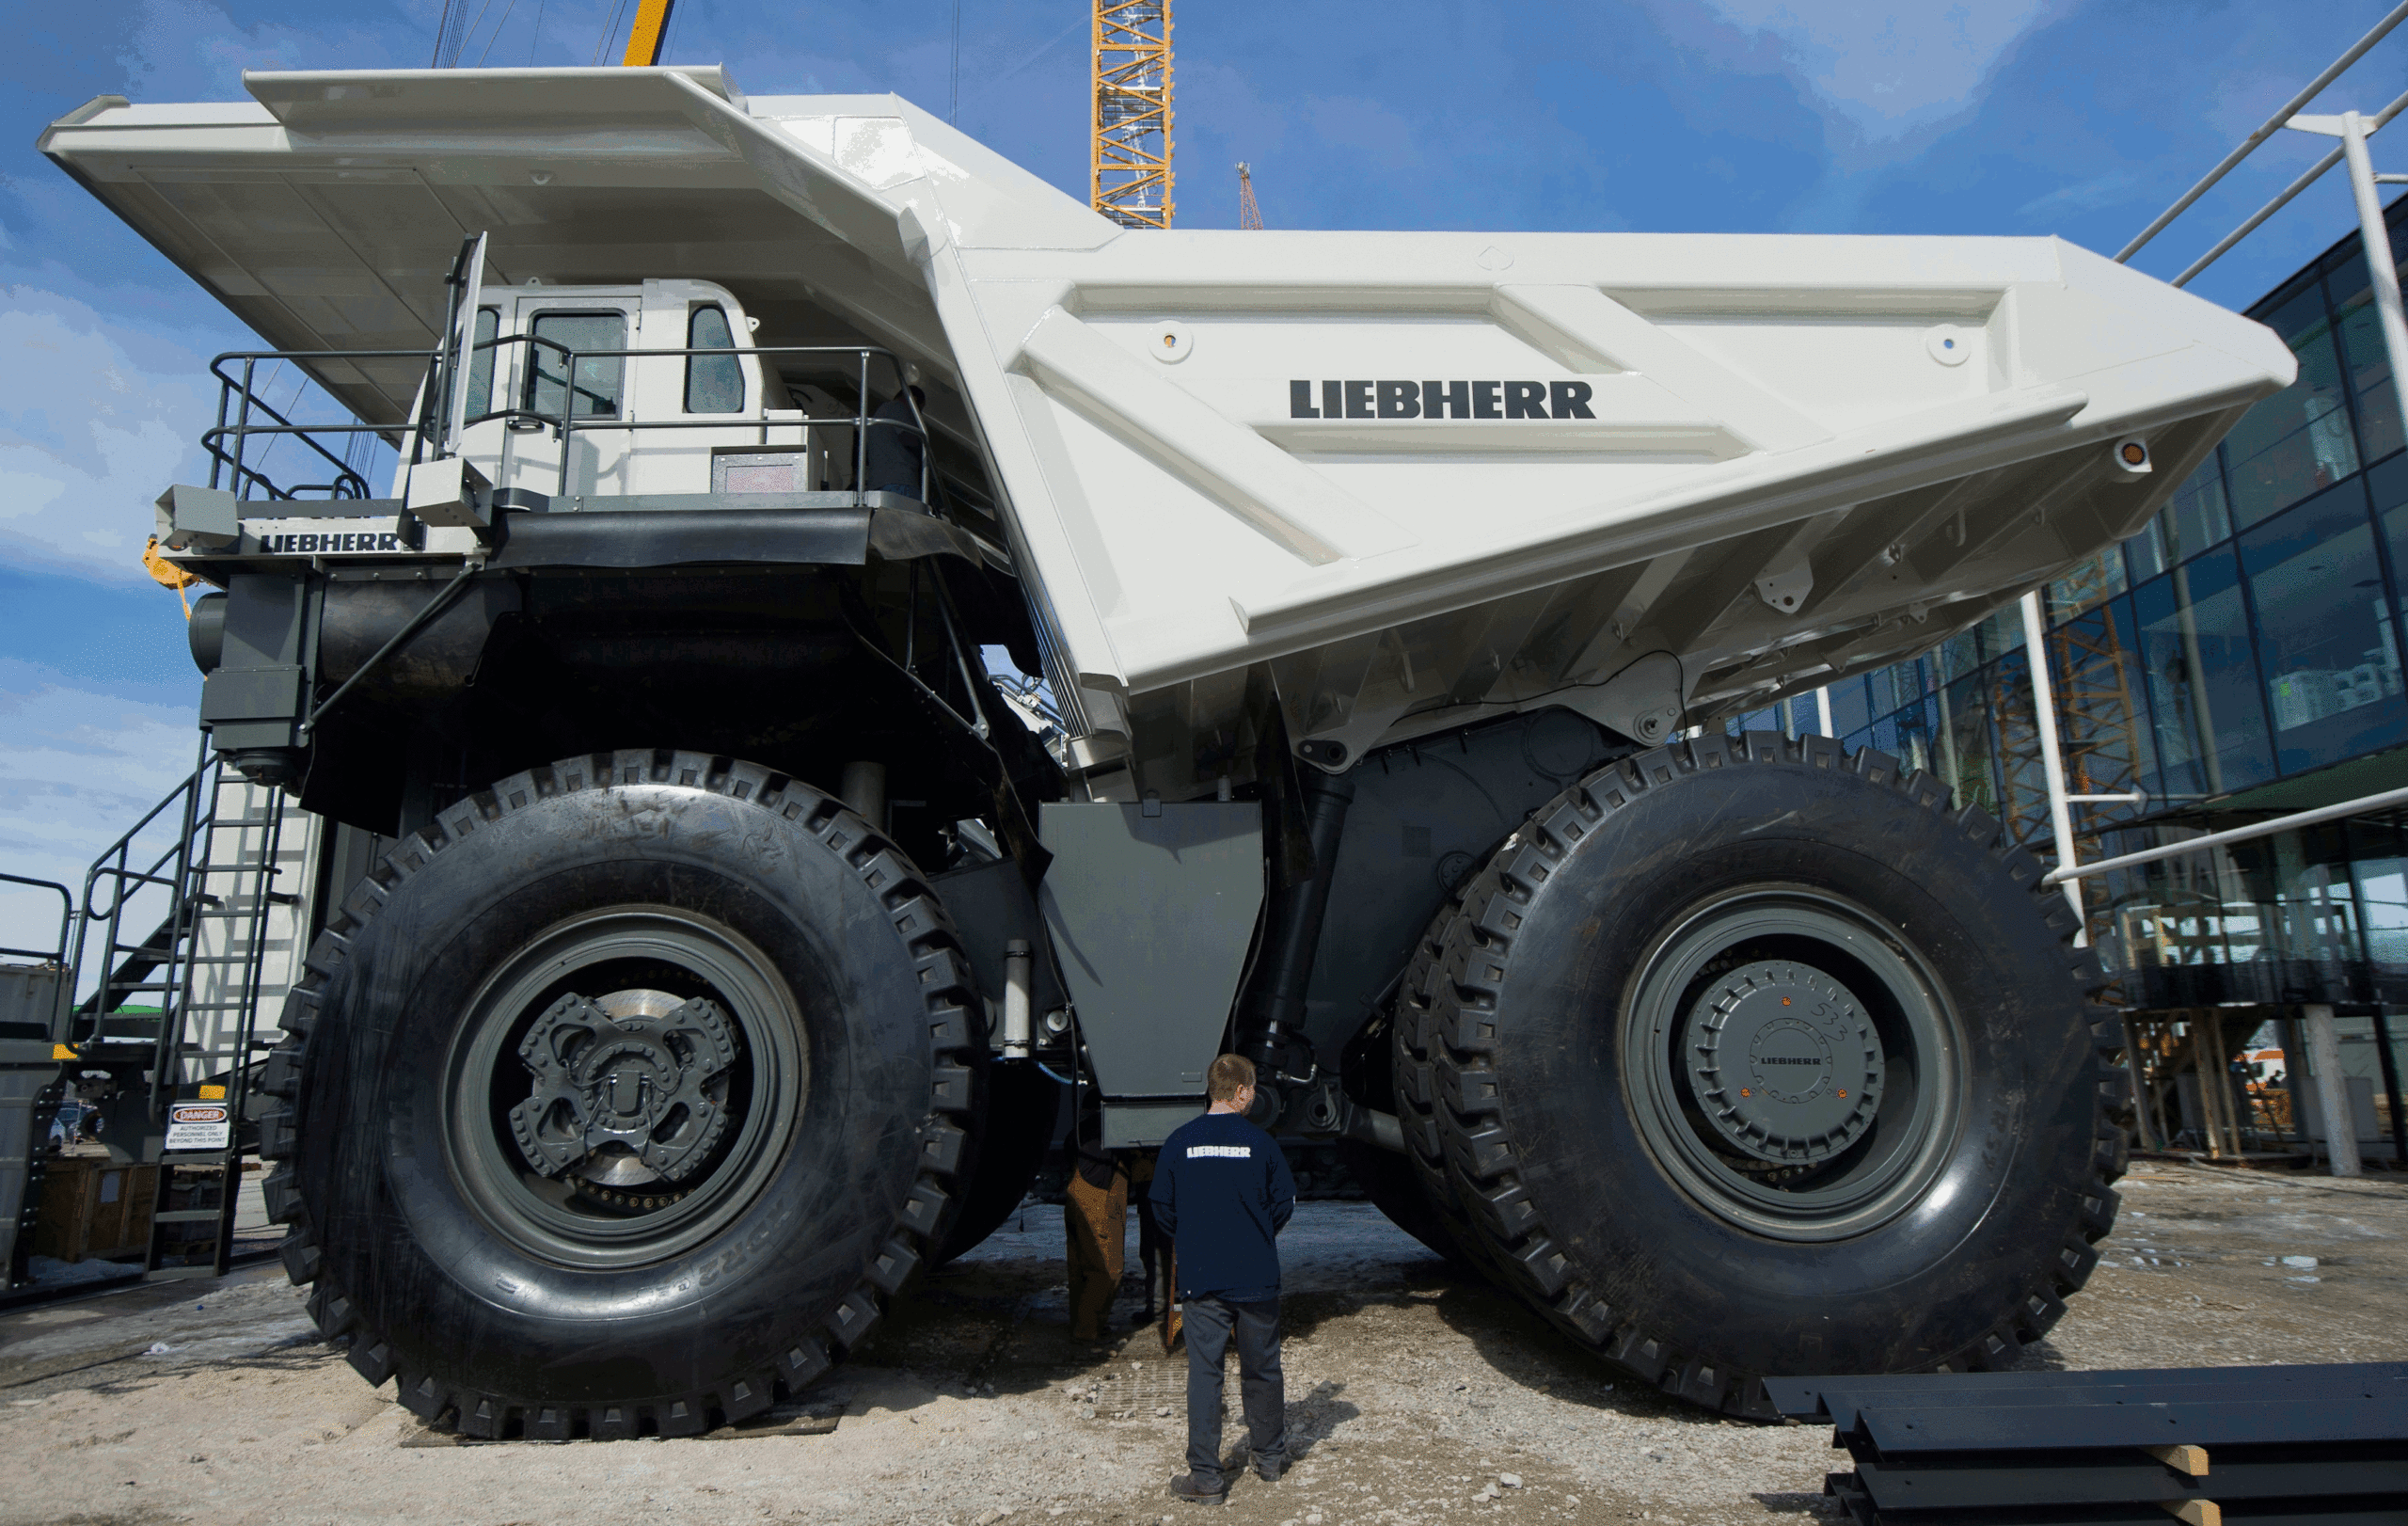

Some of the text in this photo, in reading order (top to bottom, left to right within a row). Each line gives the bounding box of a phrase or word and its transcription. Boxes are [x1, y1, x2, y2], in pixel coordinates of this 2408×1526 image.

[1290, 380, 1597, 420] LIEBHERR
[260, 533, 399, 553] LIEBHERR
[180, 1110, 219, 1120] DANGER
[1187, 1146, 1251, 1158] LIEBHERR
